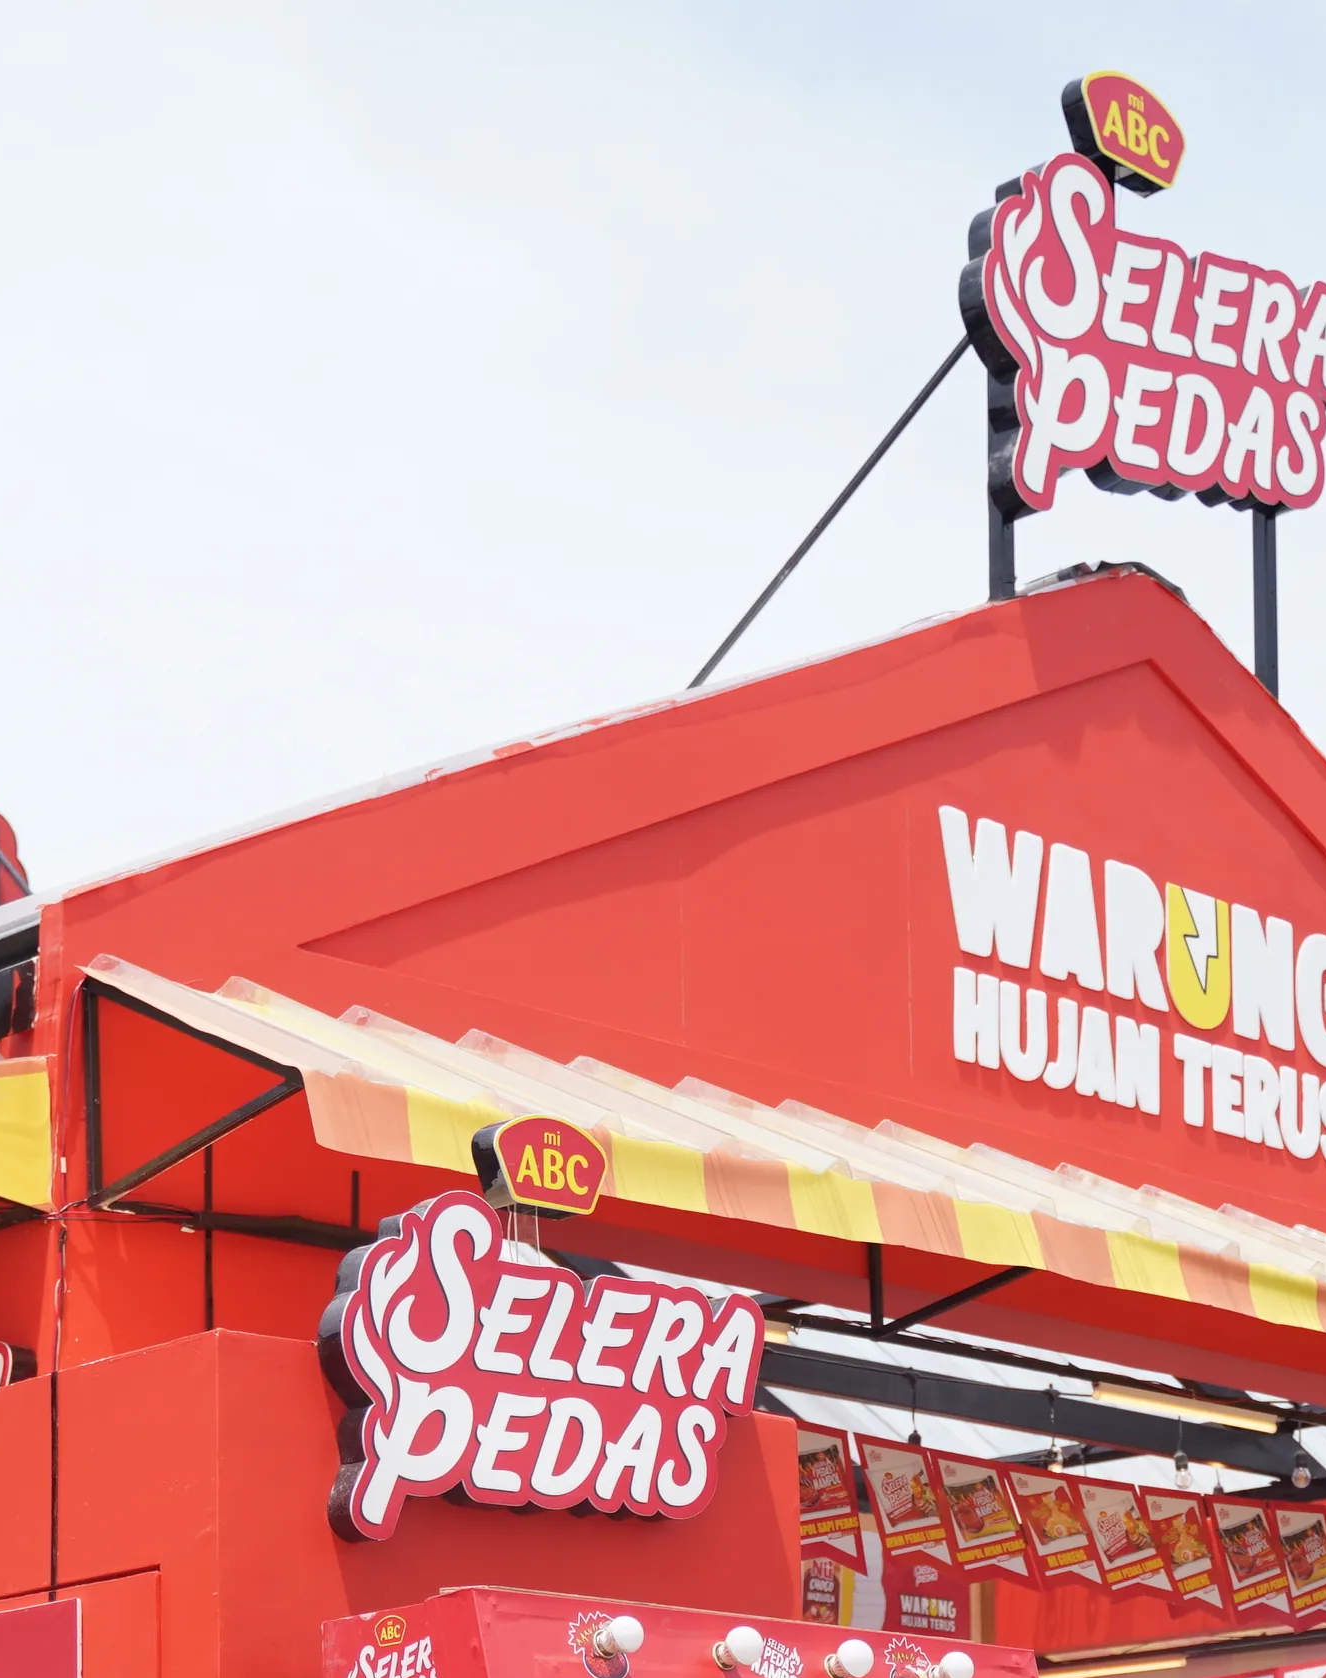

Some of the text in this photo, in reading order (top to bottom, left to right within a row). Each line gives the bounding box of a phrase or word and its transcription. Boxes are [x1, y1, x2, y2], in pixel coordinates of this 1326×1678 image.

[1128, 93, 1145, 112] mi
[1102, 112, 1171, 169] ABC
[1022, 337, 1321, 498] PEDAS
[953, 967, 1160, 1115] HUJAN
[543, 1131, 561, 1146] mi
[516, 1145, 589, 1196] ABC
[389, 1204, 756, 1404] SELERA
[362, 1373, 717, 1524] PEDAS
[900, 1594, 957, 1619] WARUNG
[380, 1624, 401, 1641] ABC
[901, 1614, 956, 1632] HUJAN TERUS
[764, 1645, 796, 1675] PEDAS
[766, 1637, 790, 1657] SELERA
